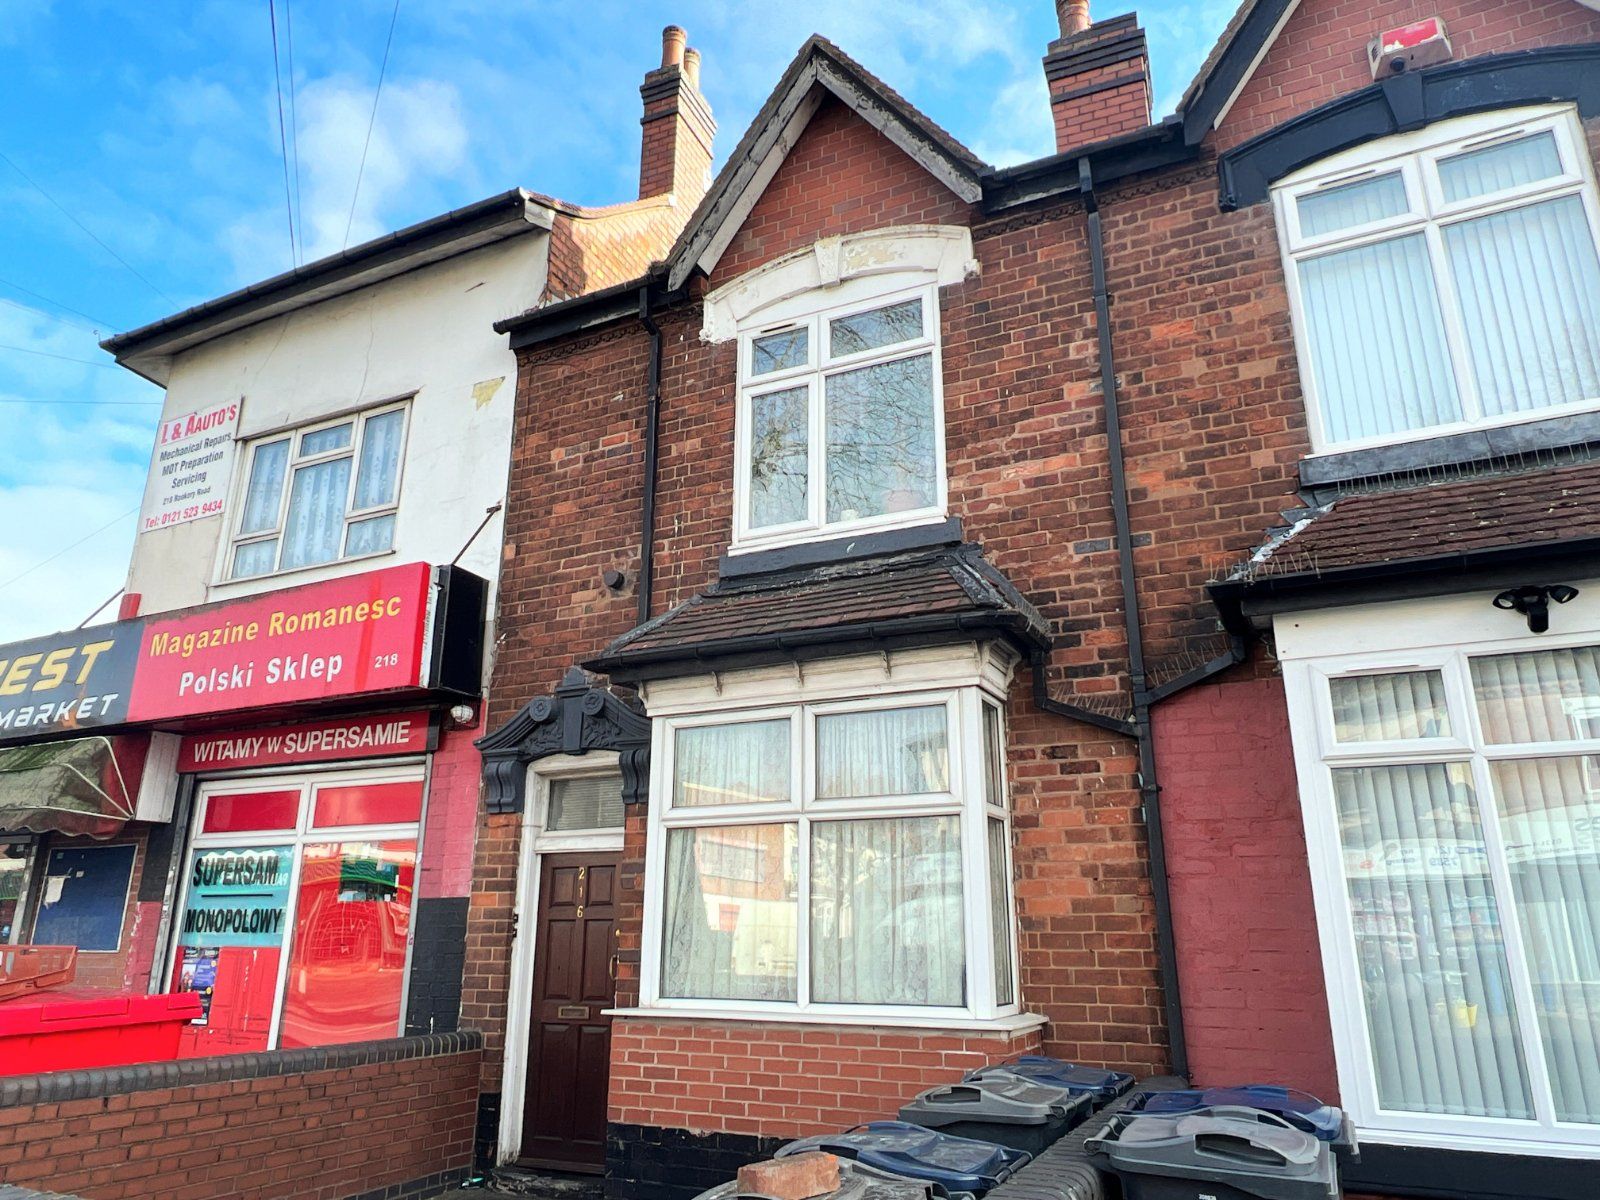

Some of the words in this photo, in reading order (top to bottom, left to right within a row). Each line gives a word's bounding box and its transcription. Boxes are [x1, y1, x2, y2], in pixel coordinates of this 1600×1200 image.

[160, 441, 202, 461] Mechanical
[204, 432, 232, 448] Repairs
[161, 462, 179, 477] MOT
[180, 451, 223, 469] Preparation
[171, 471, 207, 488] Servicing
[161, 511, 181, 525] 0121
[183, 505, 199, 519] 523
[202, 499, 223, 514] 9434
[150, 620, 260, 658] Magazine
[268, 596, 402, 637] Romanesc
[178, 662, 254, 697] Polski
[265, 653, 344, 684] Sklep
[374, 653, 399, 670] 218
[193, 736, 264, 763] WITAMY
[283, 720, 412, 755] SUPERSAMIE
[193, 855, 279, 887] SUPERSAM
[184, 908, 282, 933] MONOPOLOWY
